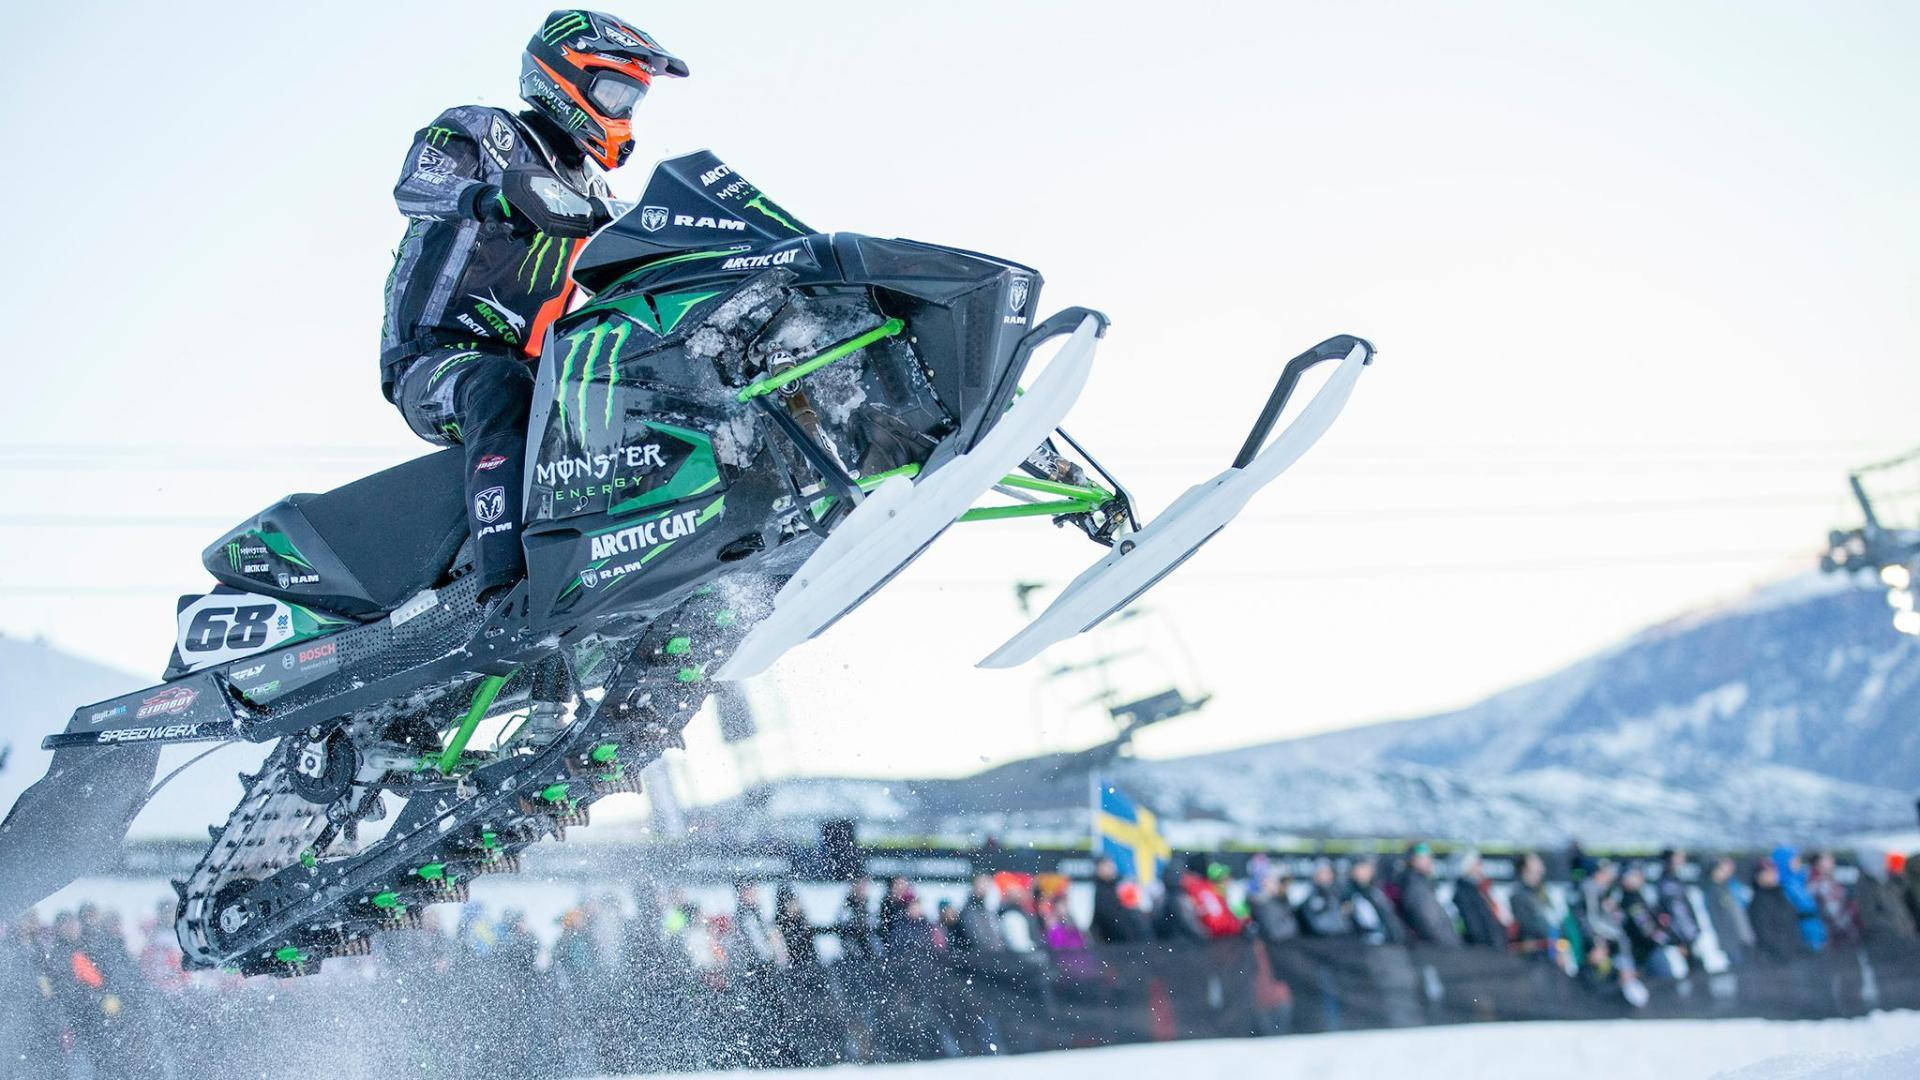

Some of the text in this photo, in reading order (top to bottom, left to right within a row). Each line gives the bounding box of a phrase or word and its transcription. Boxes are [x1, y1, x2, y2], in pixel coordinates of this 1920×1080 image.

[674, 214, 746, 231] RAM
[722, 249, 799, 270] ARCTIC CAT
[474, 302, 509, 335] ARCTIC
[1003, 316, 1027, 324] RAM
[536, 443, 667, 486] MONSTER
[555, 475, 643, 501] ENERGY
[591, 522, 658, 561] ARCTIC
[290, 574, 319, 584] RAM
[600, 561, 642, 580] RAM
[185, 604, 277, 652] 68
[299, 642, 336, 663] BOSCH
[98, 722, 203, 742] SPEEDWERX
